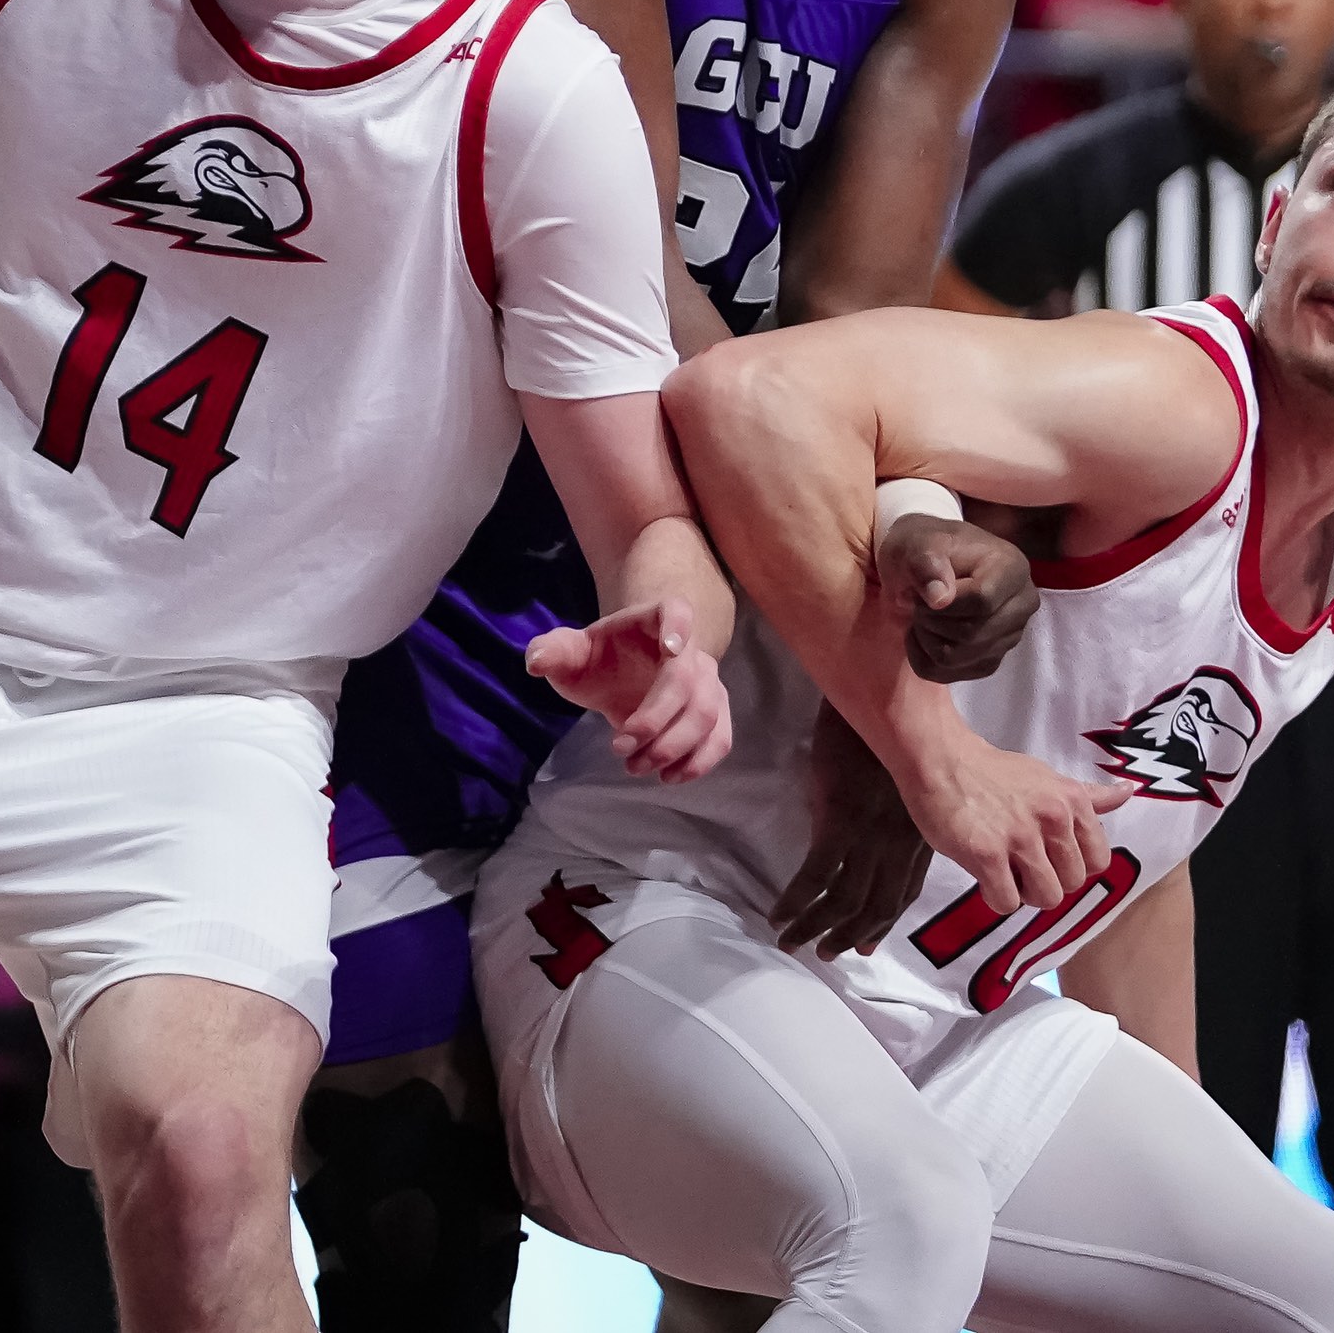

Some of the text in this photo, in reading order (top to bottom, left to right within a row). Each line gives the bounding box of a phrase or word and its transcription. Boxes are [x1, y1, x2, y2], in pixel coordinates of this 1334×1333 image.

[443, 37, 482, 63] AC
[674, 19, 836, 148] GCU
[33, 260, 268, 539] 14
